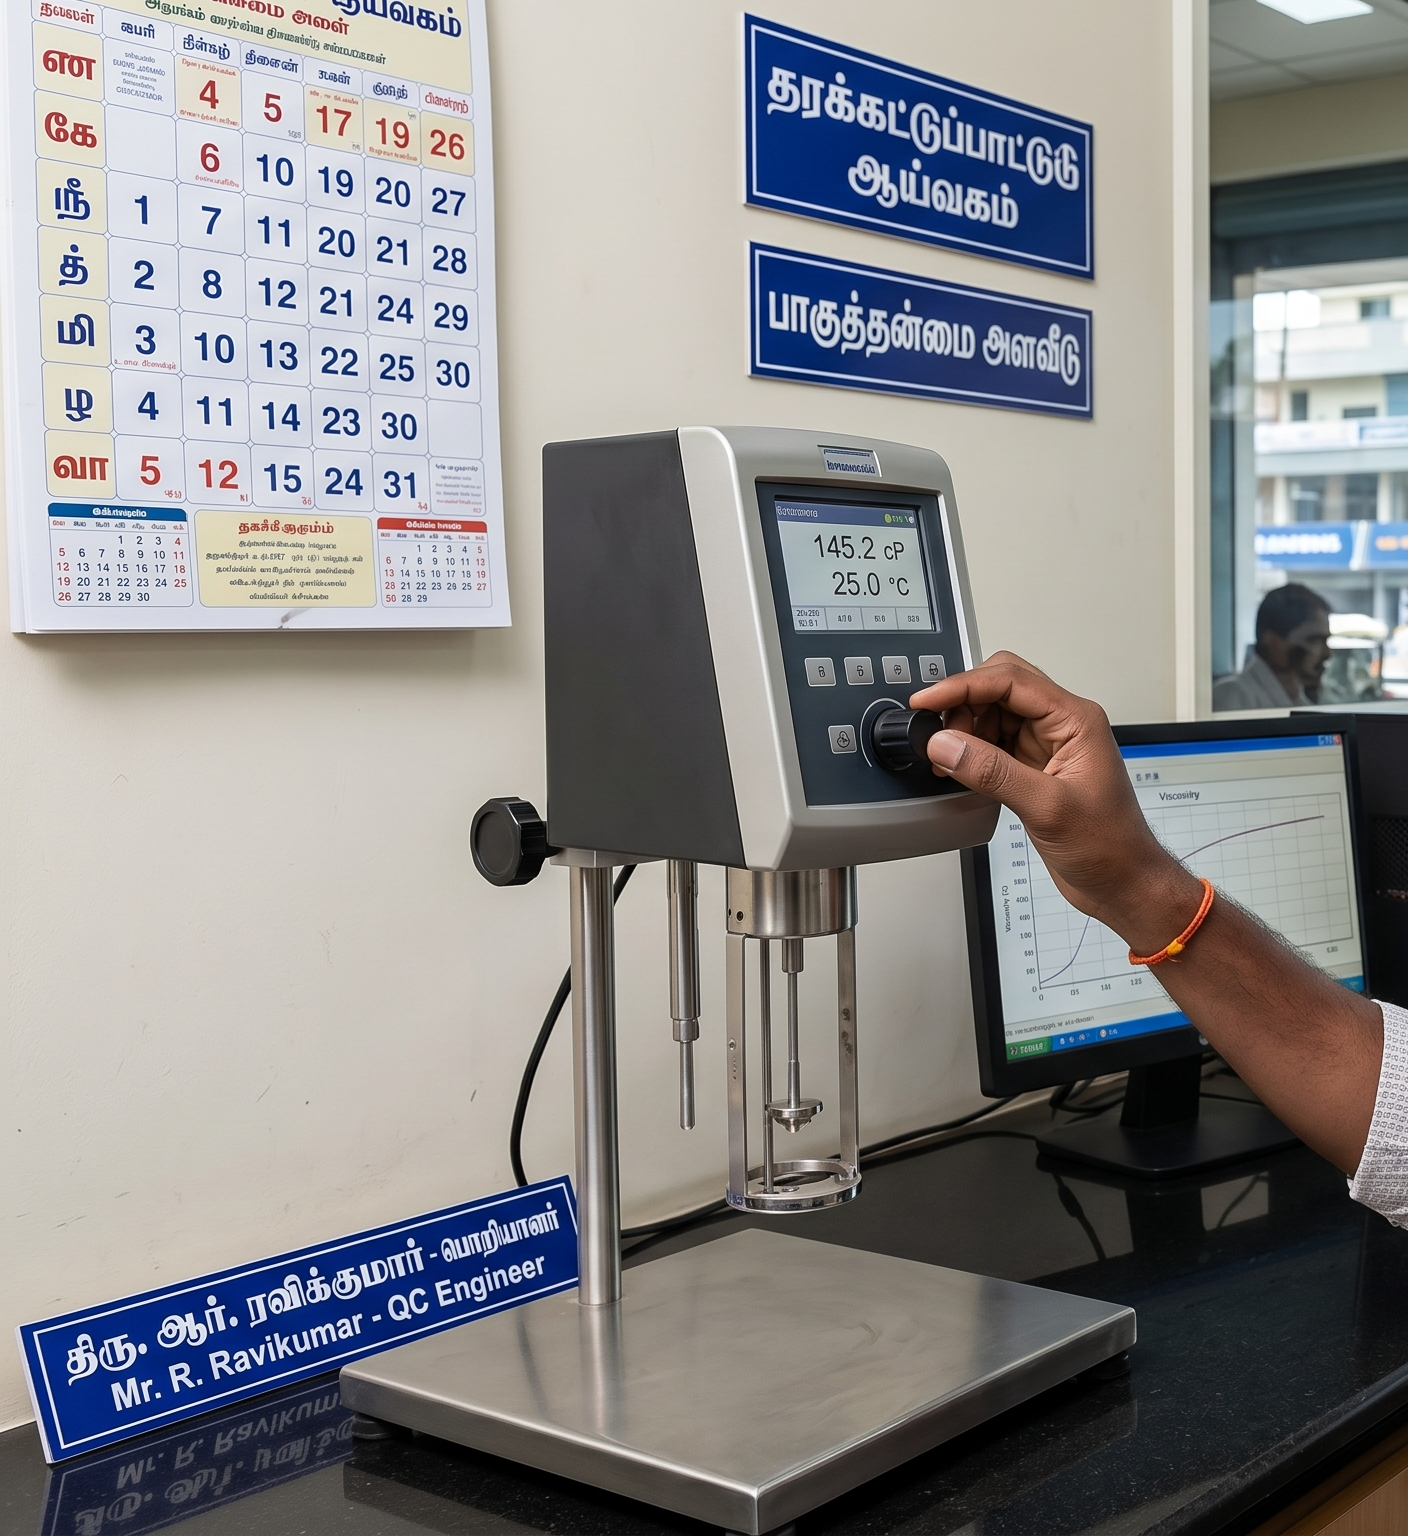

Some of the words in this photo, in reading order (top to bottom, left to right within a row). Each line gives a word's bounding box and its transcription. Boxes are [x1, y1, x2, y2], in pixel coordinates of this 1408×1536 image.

[200, 80, 219, 109] 4
[264, 93, 281, 122] 5
[317, 106, 351, 136] 17
[376, 118, 409, 148] 19
[431, 130, 464, 160] 26
[45, 112, 97, 148] கே
[201, 143, 219, 172] 6
[257, 154, 293, 186] 10
[318, 166, 353, 197] 19
[376, 177, 410, 207] 20
[432, 188, 465, 216] 27
[847, 154, 1019, 229] ஆய்வகம்
[135, 195, 147, 224] 1
[202, 206, 221, 234] 7
[258, 216, 289, 247] 11
[319, 227, 355, 257] 20
[377, 236, 407, 265] 21
[433, 245, 466, 274] 28
[59, 244, 88, 286] த்
[134, 260, 154, 290] 2
[203, 270, 222, 298] 8
[259, 278, 296, 309] 12
[320, 287, 351, 316] 21
[378, 295, 413, 324] 24
[435, 303, 468, 331] 29
[58, 314, 94, 346] மி
[136, 325, 155, 354] 3
[195, 332, 234, 363] 10
[260, 340, 297, 370] 13
[321, 347, 358, 376] 22
[380, 354, 414, 382] 25
[437, 360, 469, 388] 30
[768, 288, 976, 358] பாகுத்தன்மை
[981, 322, 1081, 387] அளவீடு
[65, 389, 92, 421] ழ
[138, 392, 159, 420] 4
[197, 396, 231, 426] 11
[262, 402, 300, 431] 14
[323, 407, 360, 436] 23
[382, 412, 417, 440] 30
[54, 456, 108, 480] வா
[141, 456, 160, 485] 5
[199, 460, 238, 489] 12
[264, 464, 301, 493] 15
[325, 468, 363, 495] 24
[384, 471, 415, 498] 31
[58, 548, 65, 556] 5
[78, 549, 85, 557] 6
[98, 549, 104, 557] 7
[118, 550, 124, 558] 8
[137, 550, 143, 558] 9
[153, 551, 165, 559] 10
[118, 536, 122, 544] 1
[136, 536, 142, 544] 2
[155, 537, 161, 545] 3
[446, 545, 452, 553] 3
[815, 535, 875, 559] 145.2
[884, 542, 904, 560] cP
[56, 562, 69, 571] 12
[76, 563, 89, 571] 13
[97, 563, 109, 571] 14
[116, 564, 128, 572] 15
[135, 564, 147, 572] 16
[154, 565, 165, 573] 17
[174, 565, 185, 573] 18
[57, 577, 70, 586] 19
[76, 577, 90, 586] 20
[97, 578, 109, 586] 21
[116, 578, 129, 586] 22
[136, 578, 149, 587] 23
[155, 579, 167, 587] 24
[174, 579, 186, 587] 25
[384, 569, 394, 577] 13
[833, 572, 880, 595] 25.0
[889, 578, 909, 595] °C
[57, 592, 71, 601] 26
[77, 593, 90, 601] 27
[97, 593, 111, 601] 28
[117, 593, 130, 601] 29
[137, 593, 149, 601] 30
[66, 1333, 147, 1386] திரு.
[157, 1295, 238, 1348] ஆர்.
[246, 1238, 424, 1328] ரவிக்குமார்
[111, 1377, 161, 1412] Mr.
[169, 1363, 203, 1393] R.
[209, 1313, 363, 1381] Ravikumar
[372, 1314, 382, 1322] -
[388, 1288, 429, 1321] QC
[435, 1256, 544, 1307] Engineer
